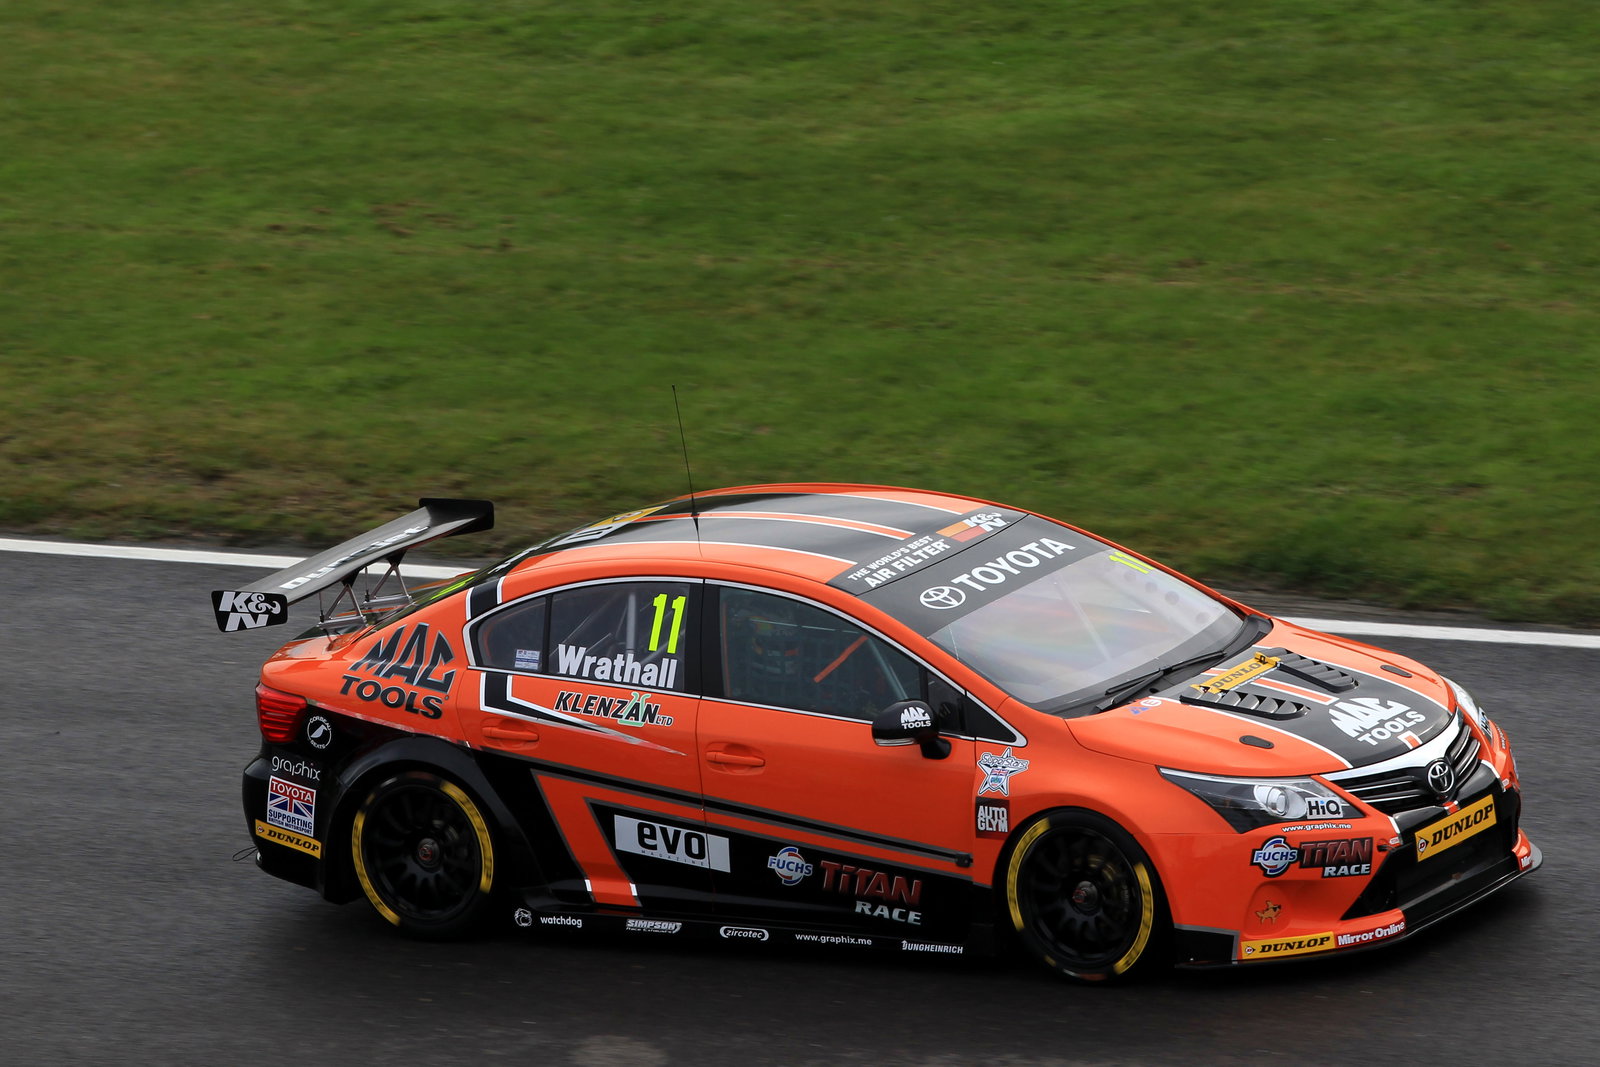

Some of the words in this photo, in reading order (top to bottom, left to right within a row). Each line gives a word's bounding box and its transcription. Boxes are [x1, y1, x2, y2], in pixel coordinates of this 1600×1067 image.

[848, 567, 870, 581] THE
[866, 546, 907, 569] WORLD'S
[907, 535, 934, 550] BEST
[864, 567, 897, 588] AIR
[891, 540, 951, 572] FILTER
[951, 537, 1076, 592] TOYOTA
[649, 593, 686, 654] 11
[348, 622, 457, 695] MAC
[558, 643, 678, 689] Wrathall
[339, 674, 444, 720] TOOLS
[555, 691, 660, 725] KLENZAN
[655, 716, 674, 727] LTD
[900, 706, 931, 724] MAC
[1328, 697, 1411, 738] MAC
[902, 720, 932, 730] TOOLS
[1357, 710, 1426, 746] TOOLS
[271, 756, 321, 781] graphix
[271, 780, 313, 803] TOYOTA
[978, 805, 1008, 820] AUTO
[1307, 798, 1342, 818] HiQ
[268, 809, 313, 830] SUPPORTING
[285, 822, 313, 835] MOTORSPORT
[977, 818, 1008, 833] GLYM
[1281, 822, 1352, 834] www.graphix.me
[1431, 803, 1494, 847] DUNLOP
[267, 829, 320, 852] DUNLOP
[637, 821, 706, 860] evo
[768, 855, 813, 877] FUCHS
[1253, 850, 1298, 864] FUCHS
[1323, 863, 1371, 877] RACE
[540, 915, 583, 928] watchdog
[855, 900, 922, 926] RACE
[626, 919, 678, 931] SIMPSON
[726, 927, 763, 939] zircotec
[1337, 930, 1375, 946] Mirror
[1375, 920, 1405, 939] Online
[795, 933, 872, 945] www.graphix.me
[900, 940, 964, 954] JUNGHEINRICH
[1259, 936, 1331, 953] DUNLOP
